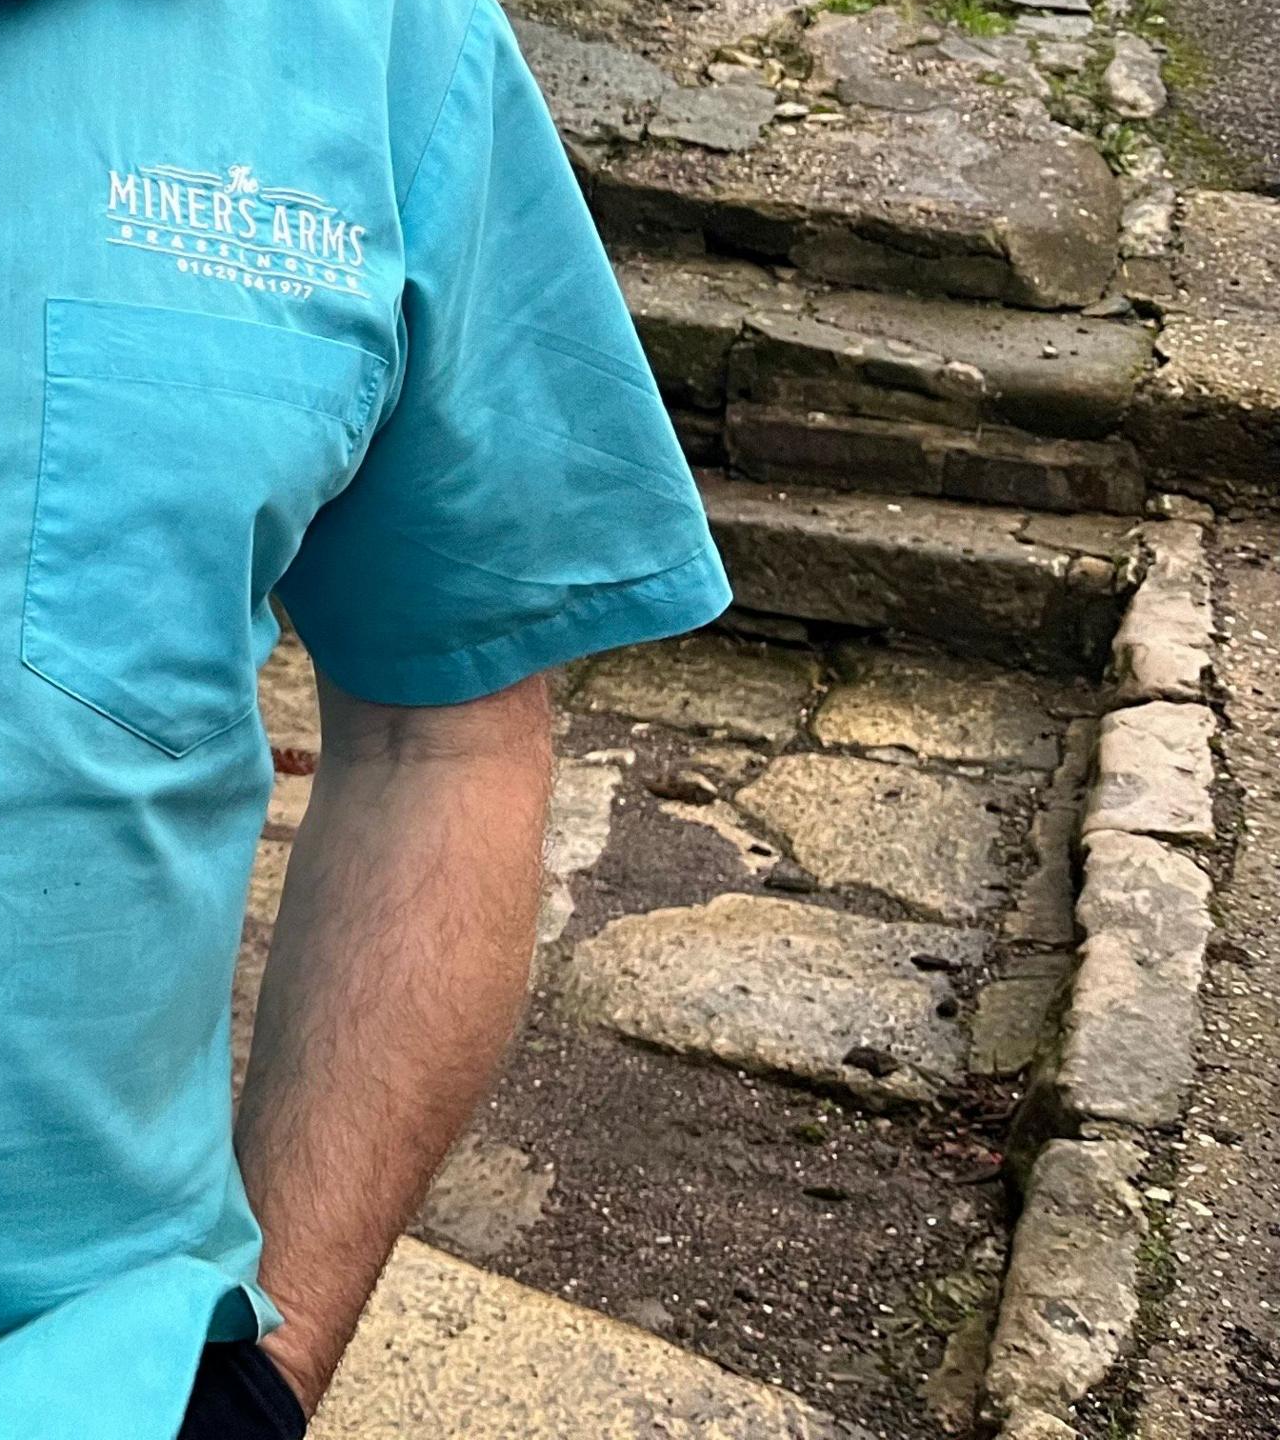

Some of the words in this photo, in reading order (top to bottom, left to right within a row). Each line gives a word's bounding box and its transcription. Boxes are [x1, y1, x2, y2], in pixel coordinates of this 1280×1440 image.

[224, 164, 259, 194] The
[109, 170, 258, 239] MINERS
[272, 204, 366, 268] ARMS
[121, 225, 359, 289] BRASSINGTON
[177, 258, 237, 281] 01629
[243, 272, 314, 299] 541977
